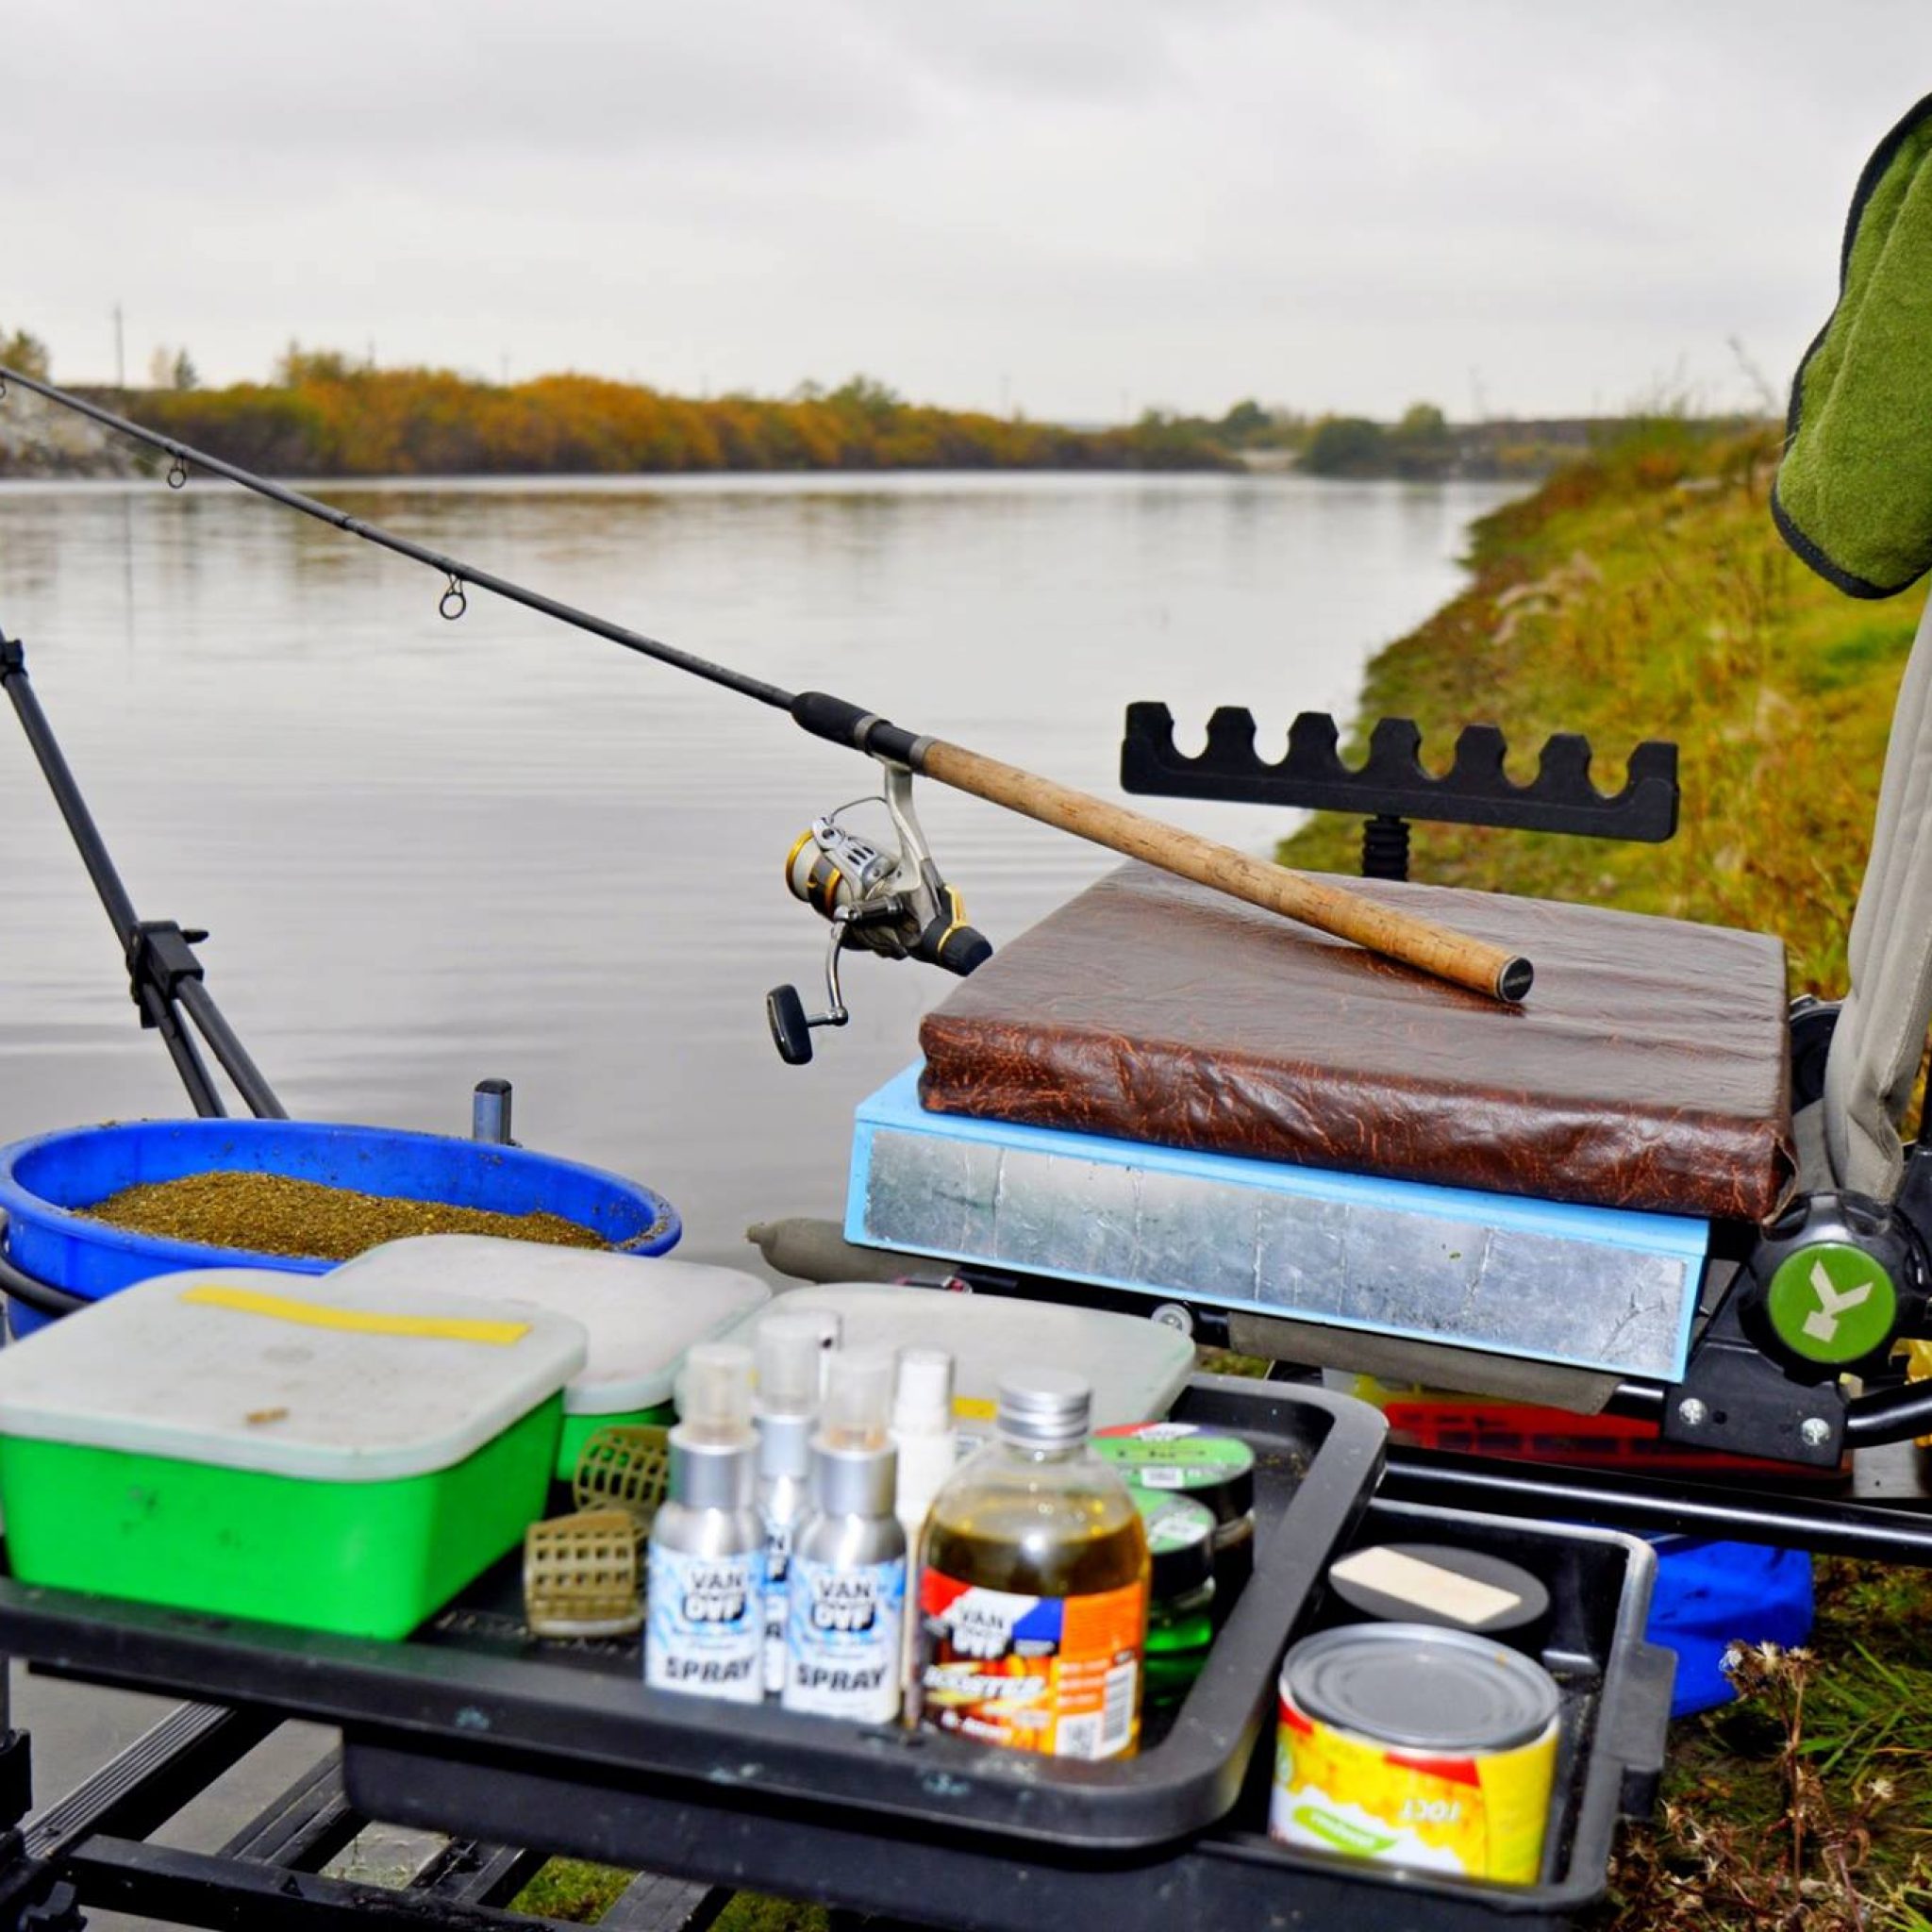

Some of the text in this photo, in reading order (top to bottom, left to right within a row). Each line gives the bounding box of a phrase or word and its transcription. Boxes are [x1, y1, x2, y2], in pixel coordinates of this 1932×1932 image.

[690, 1571, 743, 1591] VAN
[819, 1578, 872, 1600] VAN
[665, 1656, 756, 1684] SPRAY
[797, 1663, 889, 1693] SPRAY
